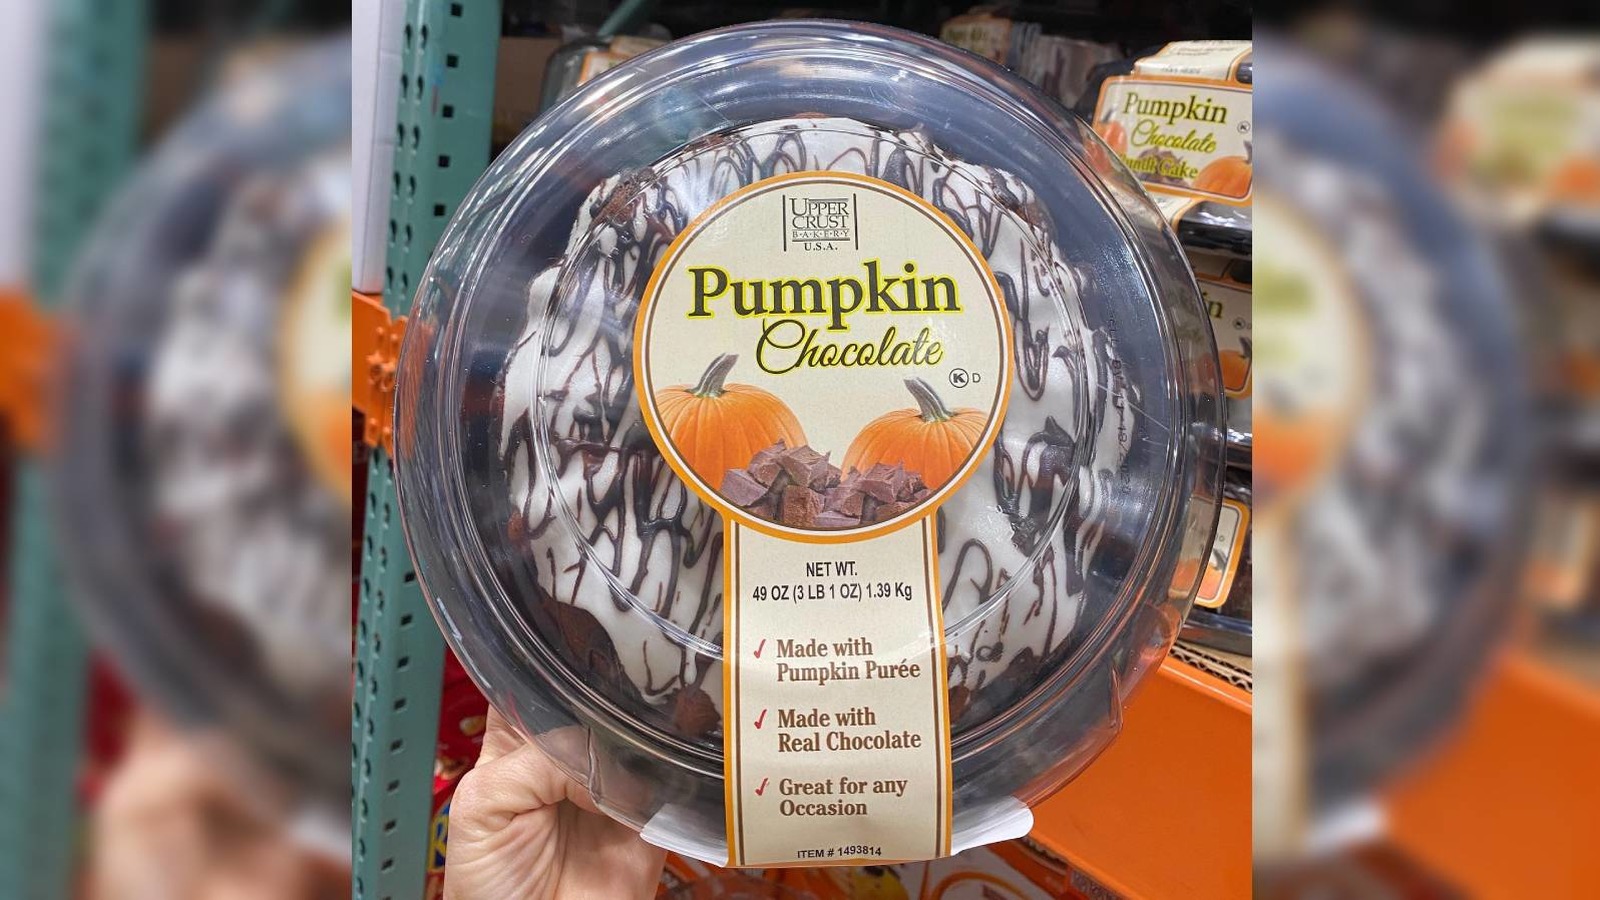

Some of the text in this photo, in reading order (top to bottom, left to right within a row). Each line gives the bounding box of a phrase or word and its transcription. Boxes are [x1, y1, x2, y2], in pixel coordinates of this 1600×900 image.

[1123, 92, 1228, 125] Pumpkin
[1130, 118, 1217, 153] Chocolate
[1159, 156, 1199, 179] Cake
[789, 197, 849, 216] UPPER
[792, 215, 849, 229] CRUST
[804, 242, 838, 251] U.S.A.
[688, 260, 962, 331] Pumpkin
[756, 318, 944, 375] Chocolate
[806, 561, 858, 577] NET WT.
[753, 582, 912, 604] 49 OZ (3 LB 1 OZ) 1.39 Kg
[777, 637, 873, 658] Made with
[777, 658, 921, 686] Pumpkin Purée
[778, 707, 876, 728] Made with
[778, 730, 922, 752] Real Chocolate
[779, 777, 908, 797] Great for any
[779, 799, 867, 816] Occasion
[797, 846, 882, 859] ITEM # 1493814
